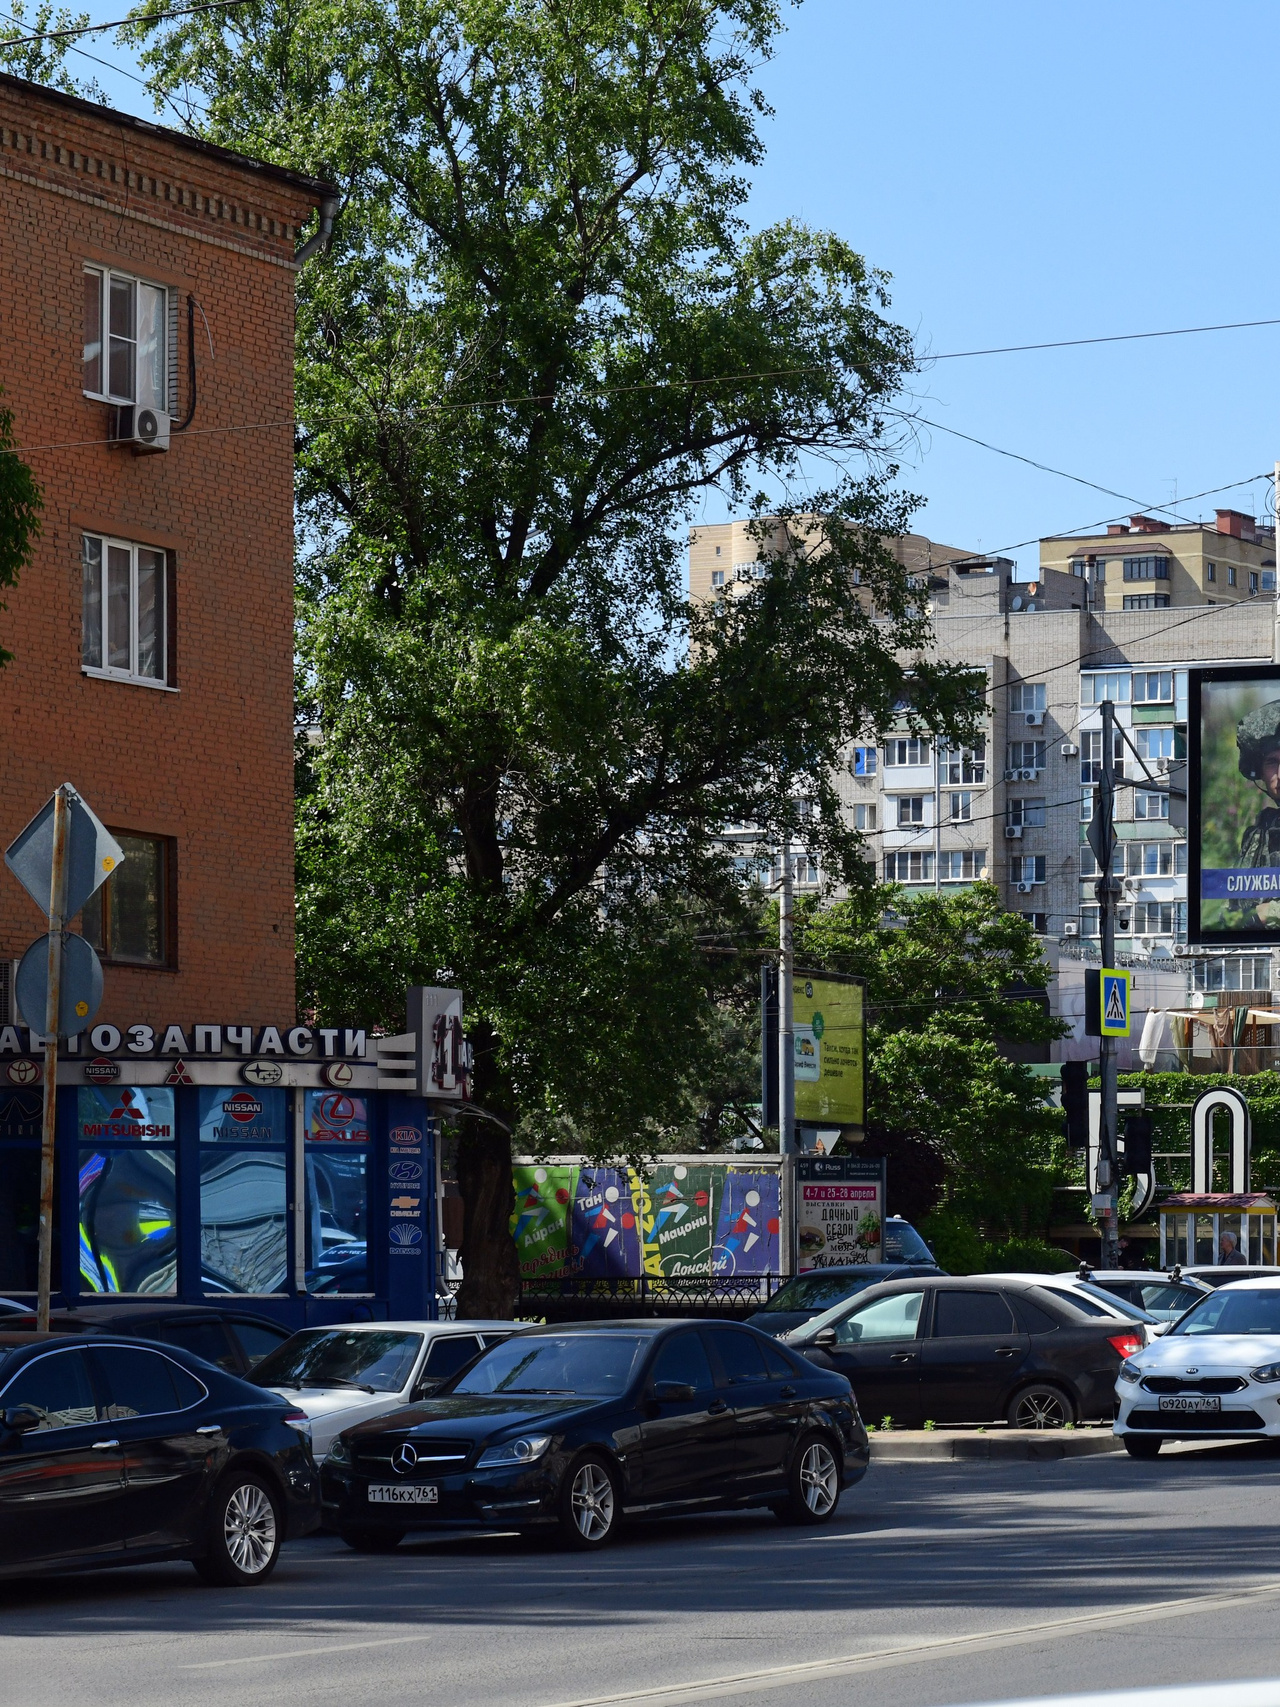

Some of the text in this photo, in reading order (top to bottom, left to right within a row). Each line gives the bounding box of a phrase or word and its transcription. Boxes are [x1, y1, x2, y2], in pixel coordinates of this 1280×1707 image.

[86, 1067, 117, 1075] NISSAN
[224, 1103, 261, 1112] NISSAN
[83, 1124, 171, 1137] MITSUBISHI
[213, 1127, 272, 1139] NISSAN
[305, 1129, 370, 1142] LEXUS
[395, 1130, 416, 1141] KIA
[825, 1163, 841, 1171] Russ
[806, 1188, 818, 1198] 4-7
[827, 1188, 848, 1198] 25-28
[850, 1190, 875, 1199] апреля
[577, 1193, 603, 1212] Тан
[821, 1205, 859, 1221] ДАЧНЫЙ
[659, 1214, 708, 1244] Мацони
[826, 1223, 854, 1237] СЕЗОН
[520, 1244, 580, 1274] арядись
[670, 1255, 727, 1277] Донской
[1162, 1398, 1217, 1409] О920АУ 761
[371, 1487, 435, 1501] Т116КХ 761
